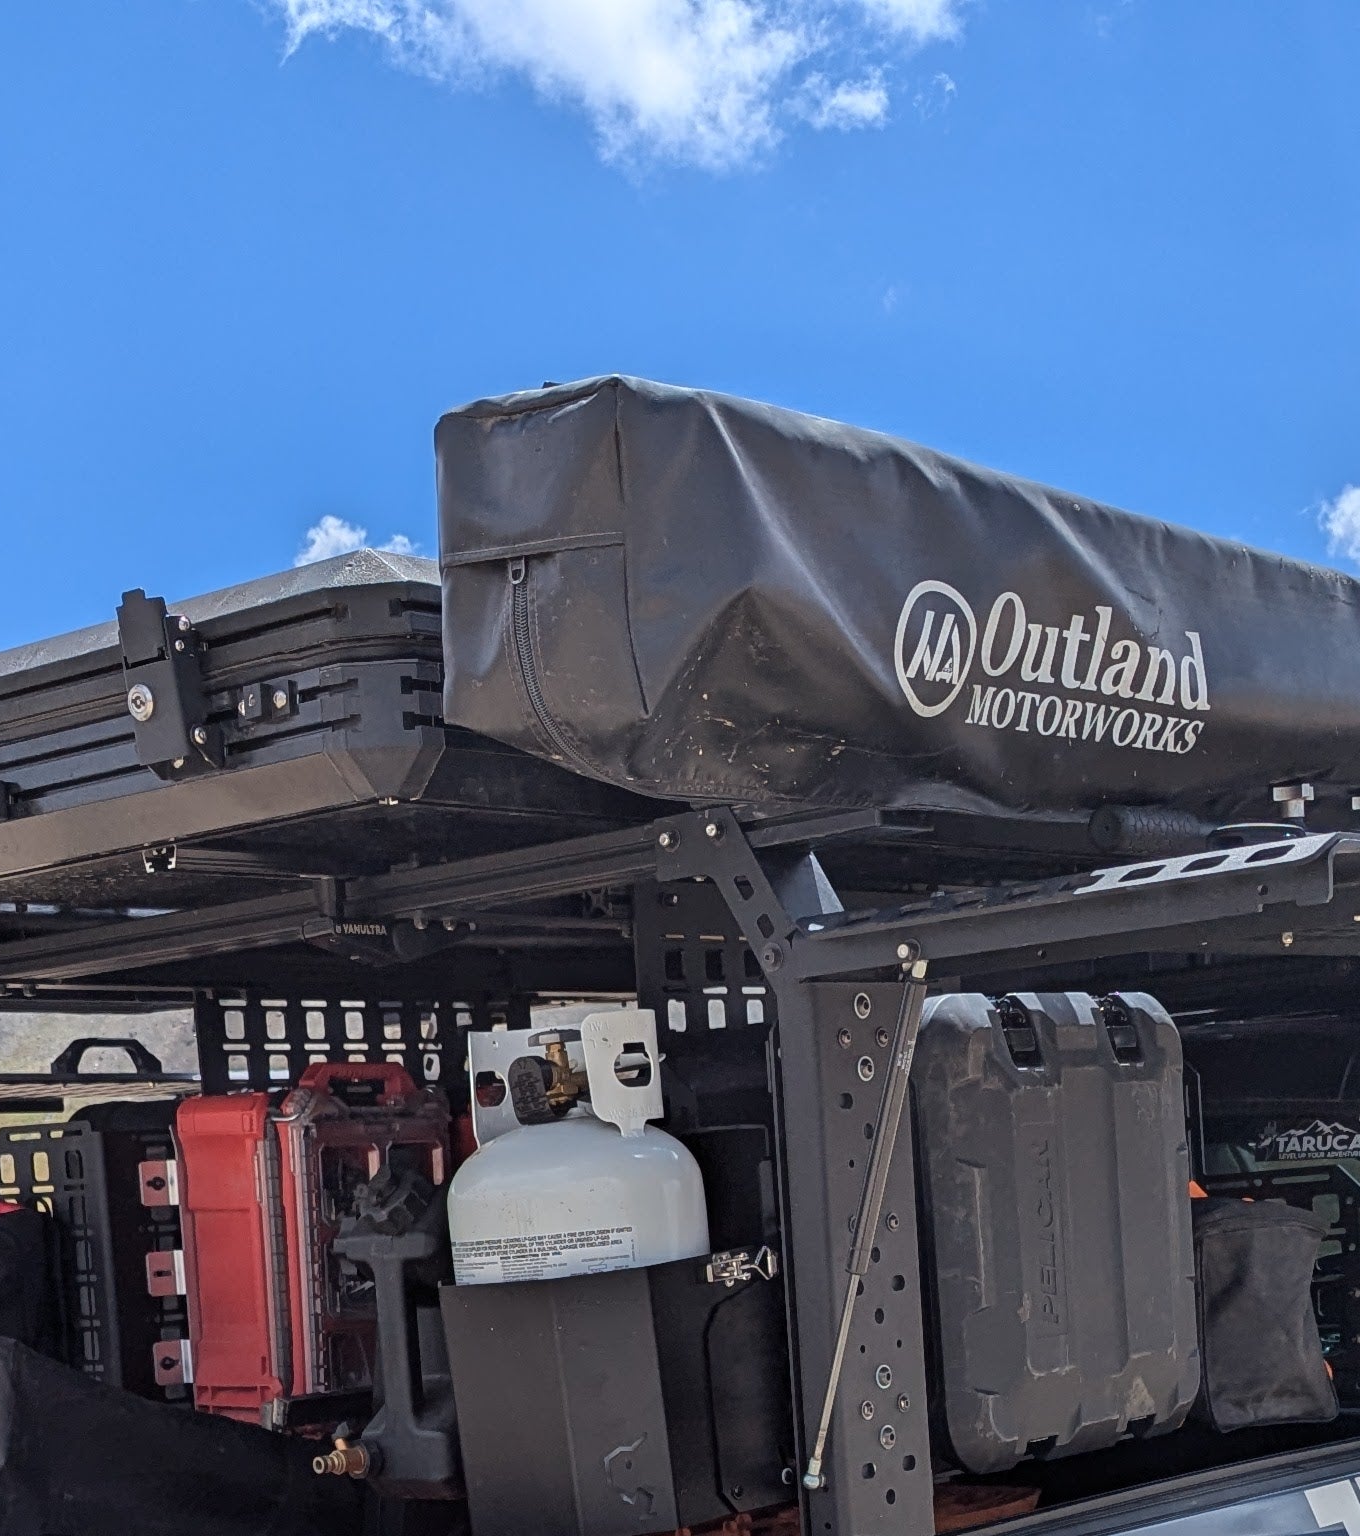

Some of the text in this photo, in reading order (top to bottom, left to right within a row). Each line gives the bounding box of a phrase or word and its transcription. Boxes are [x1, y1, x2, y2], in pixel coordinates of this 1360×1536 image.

[981, 592, 1211, 711] Outland
[965, 684, 1205, 755] MOTORWORKS
[1033, 1139, 1059, 1324] PELICAN
